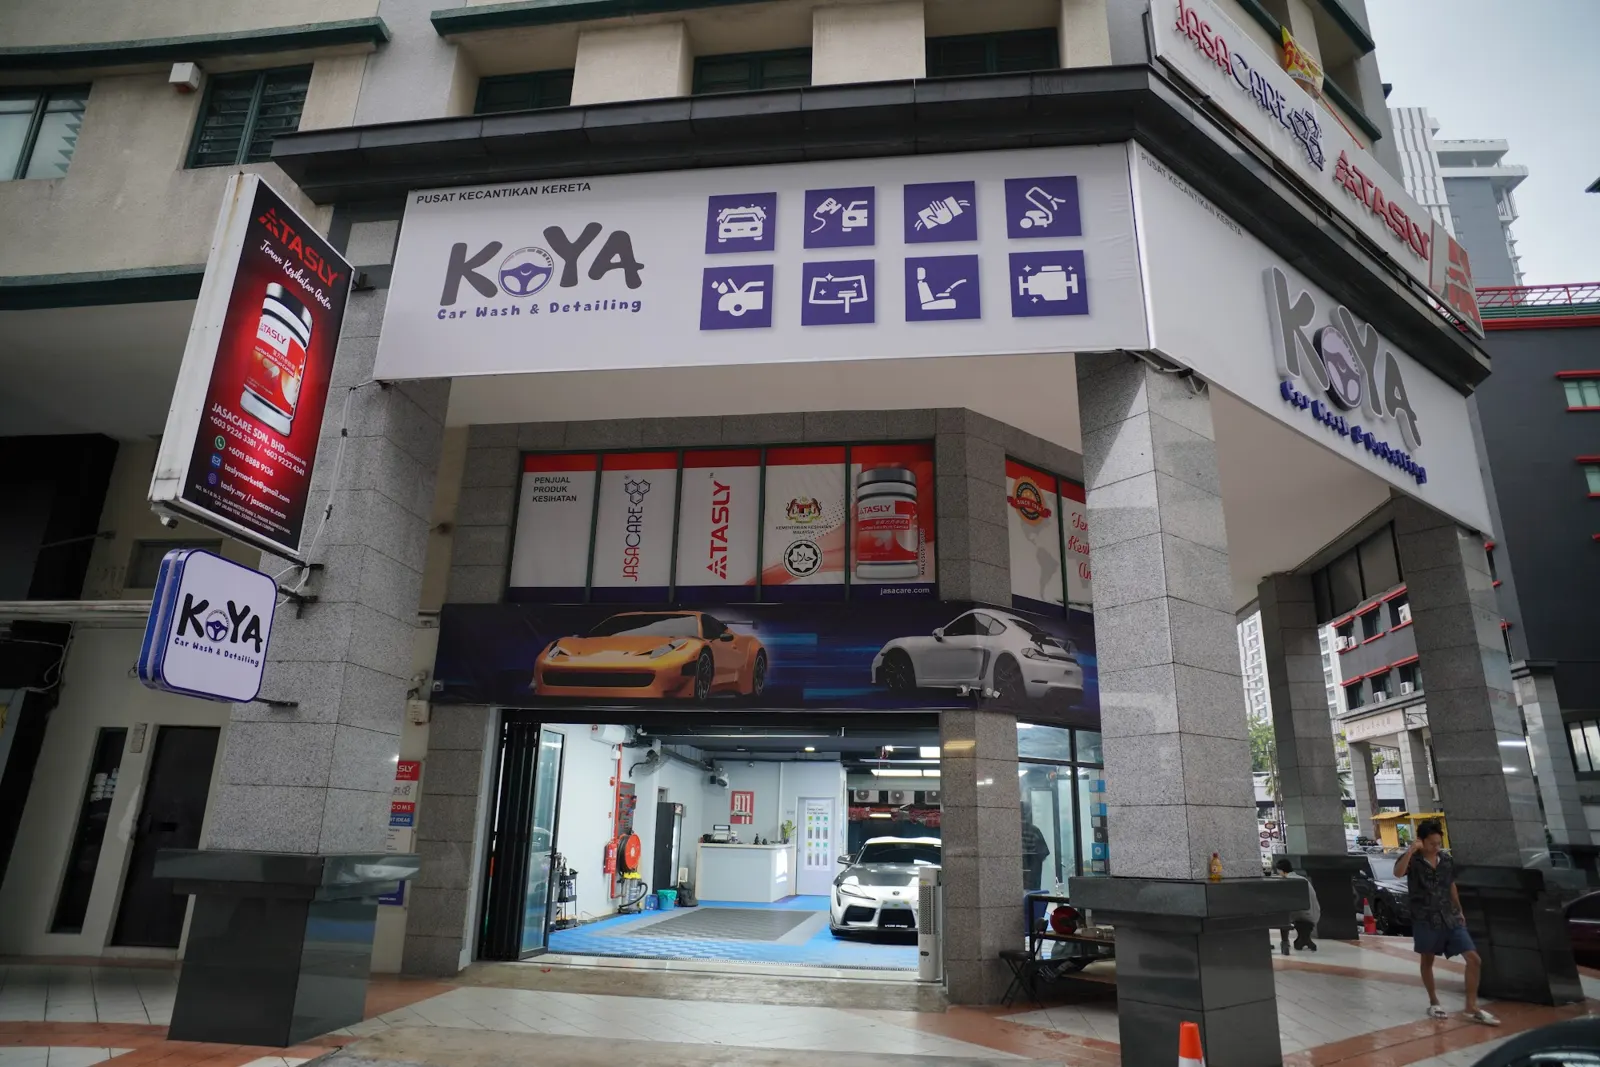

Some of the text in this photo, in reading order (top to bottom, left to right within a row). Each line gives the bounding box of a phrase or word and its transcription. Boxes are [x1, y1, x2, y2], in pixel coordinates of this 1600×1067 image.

[1176, 0, 1290, 129] JASACARE
[417, 182, 591, 205] PUSAT KECANTIKAN KERETA
[1140, 152, 1243, 238] PUSAT KECANTIKAN KERETA
[1351, 165, 1430, 260] TASLY
[259, 239, 283, 265] Teman
[282, 259, 315, 296] Kesihatan
[275, 218, 339, 288] TASLY
[263, 324, 287, 344] TASLY
[437, 299, 642, 320] Car Wash & Detailing
[210, 416, 227, 429] +603
[226, 424, 242, 440] 9226
[243, 435, 257, 448] 3381
[264, 447, 277, 460] +603
[277, 455, 293, 471] 9222
[212, 403, 252, 434] JASACARE
[253, 427, 270, 445] SDN.
[270, 439, 287, 455] BHD.
[228, 446, 244, 460] +6011
[1280, 379, 1310, 410] Car
[1311, 399, 1350, 436] Wash
[1364, 431, 1427, 485] Detailing
[710, 480, 731, 559] TASLY
[862, 504, 891, 514] TASLY
[622, 506, 643, 582] JASACARE
[880, 587, 930, 595] jasacare.com
[174, 637, 189, 647] Car
[192, 641, 213, 654] Wash
[224, 650, 260, 668] Detailing
